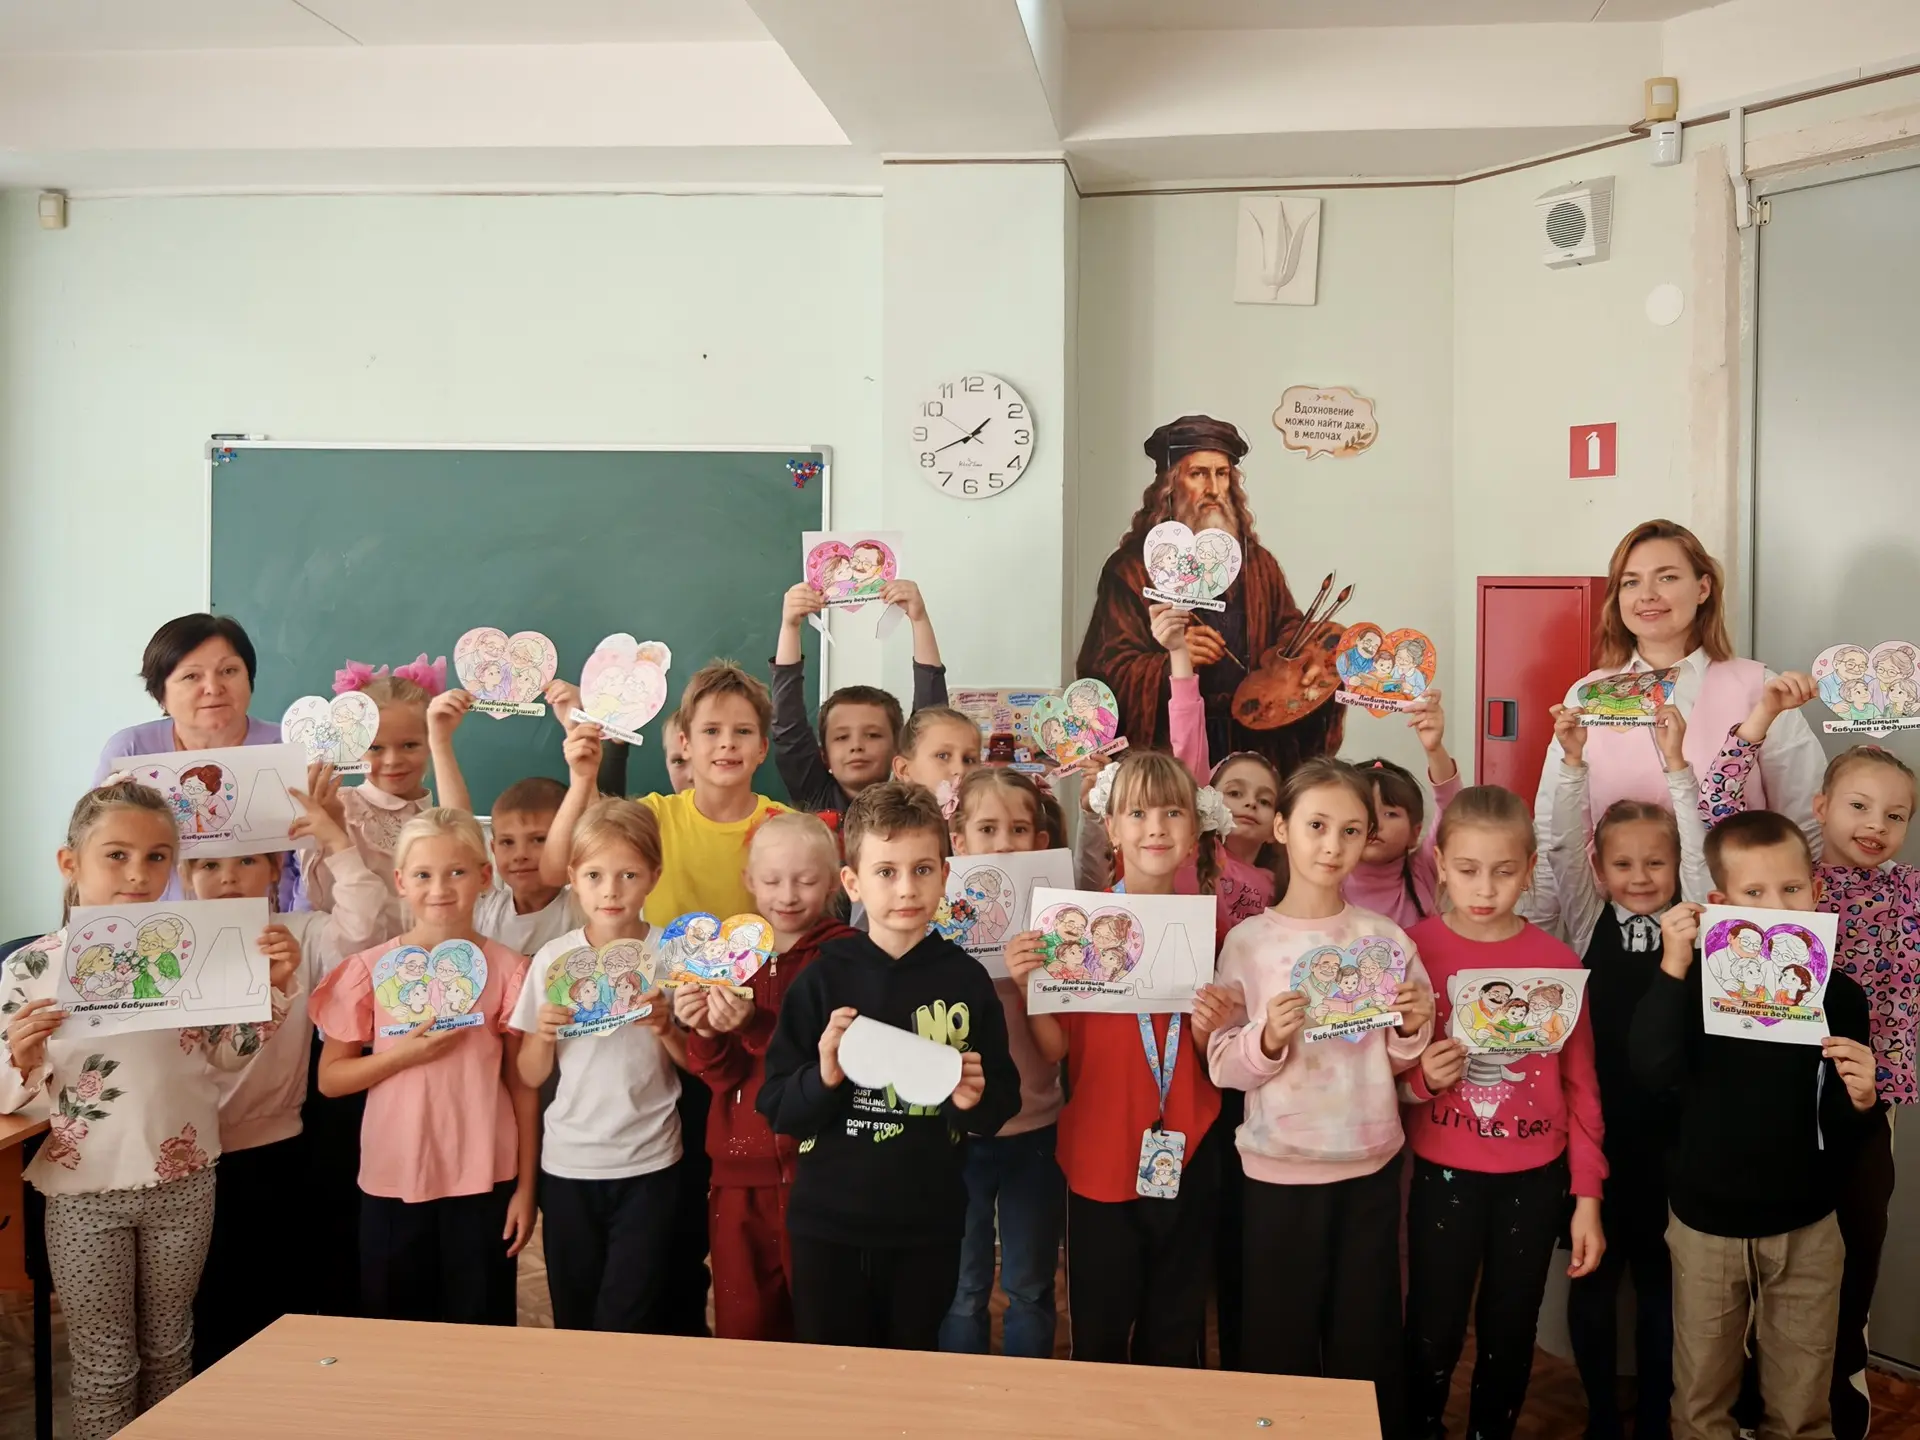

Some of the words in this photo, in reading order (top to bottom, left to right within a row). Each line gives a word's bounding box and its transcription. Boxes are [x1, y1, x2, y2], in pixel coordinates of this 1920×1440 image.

[938, 382, 954, 399] 11
[960, 376, 985, 393] 12
[993, 383, 1002, 400] 1
[920, 401, 943, 418] 10
[1007, 402, 1024, 419] 2
[1294, 401, 1354, 417] Вдохновение
[1285, 417, 1315, 427] можно
[1317, 418, 1342, 429] найти
[1344, 421, 1365, 430] даже
[912, 426, 928, 442] 9
[1014, 429, 1030, 446] 3
[1294, 430, 1300, 439] в
[1302, 432, 1342, 441] мелочах
[920, 452, 936, 468] 8
[1006, 455, 1022, 471] 4
[937, 471, 954, 488] 7
[988, 472, 1004, 489] 5
[963, 479, 979, 495] 6
[1150, 590, 1182, 604] Любимой
[1182, 598, 1218, 607] бабушке!
[479, 698, 520, 707] Любимым
[1341, 697, 1373, 709] бабушке
[1358, 694, 1398, 706] Любимым
[502, 706, 540, 715] дедушке!
[1832, 725, 1872, 733] бабушке
[181, 832, 223, 841] бабушке!
[1042, 984, 1079, 992] бабушке
[1087, 985, 1127, 995] дедушке!
[1062, 979, 1105, 987] Любимым
[73, 1001, 120, 1013] Любимой
[121, 1000, 169, 1010] бабушке!
[1720, 1004, 1761, 1015] бабушке
[1770, 1009, 1816, 1021] дедушке!
[1741, 1000, 1790, 1012] Любимым
[436, 1018, 478, 1030] дедушке!
[582, 1014, 626, 1028] Любимым
[1331, 1017, 1373, 1030] Любимым
[563, 1026, 600, 1038] бабушке
[1312, 1027, 1349, 1041] бабушке
[1357, 1018, 1397, 1032] дедушке!
[853, 1088, 872, 1096] JUST
[853, 1096, 886, 1107] CHILLING
[847, 1119, 872, 1129] DON'T
[847, 1128, 859, 1136] ME
